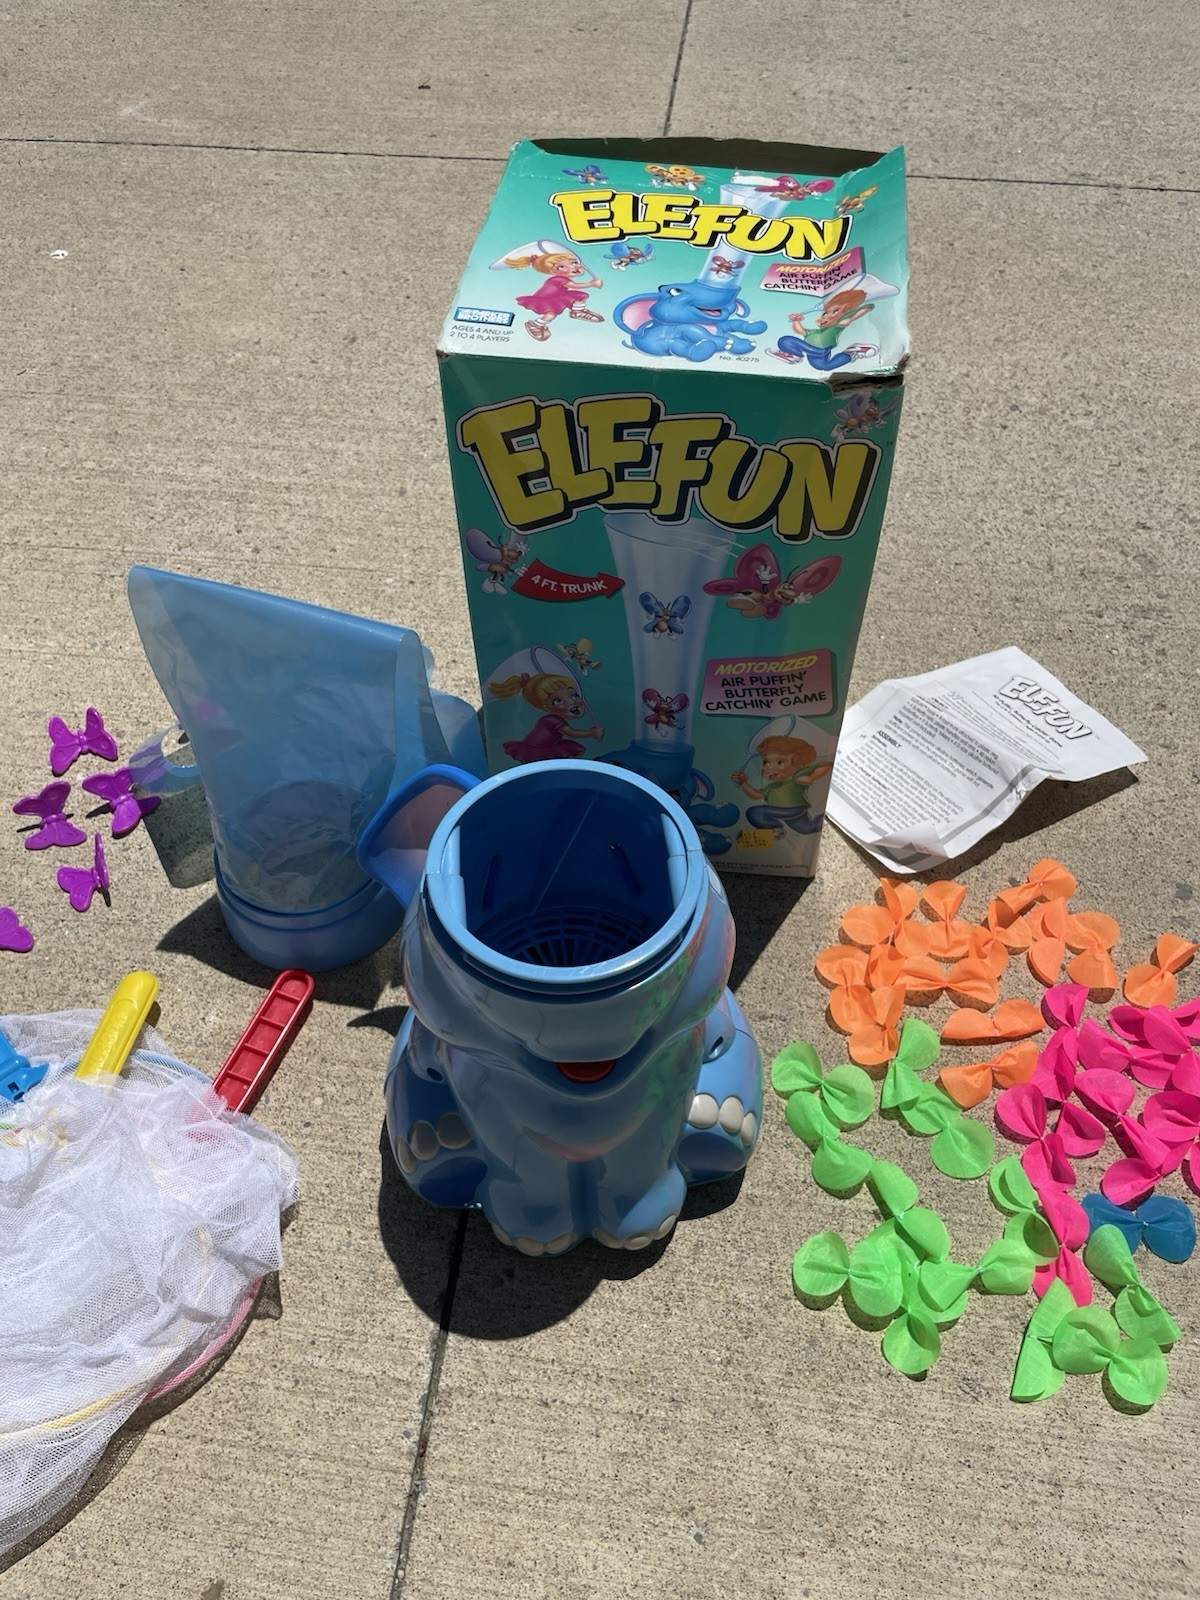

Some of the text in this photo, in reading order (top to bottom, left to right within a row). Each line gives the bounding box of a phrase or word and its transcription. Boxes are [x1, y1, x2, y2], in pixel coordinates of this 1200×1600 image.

[550, 190, 854, 261] ELEFUN
[764, 283, 819, 291] CATCHIN'
[781, 272, 841, 285] BUTTERFLY
[451, 324, 474, 333] AGES
[457, 394, 881, 543] ELEFUN
[531, 574, 608, 594] 4 FT. TRUNK
[714, 654, 818, 676] MOTORIZED
[721, 671, 807, 688] AIR PUFFIN'
[705, 690, 827, 711] CATCHIN' GAME
[724, 683, 805, 699] BUTTERFLY
[999, 675, 1093, 740] ELEFUN
